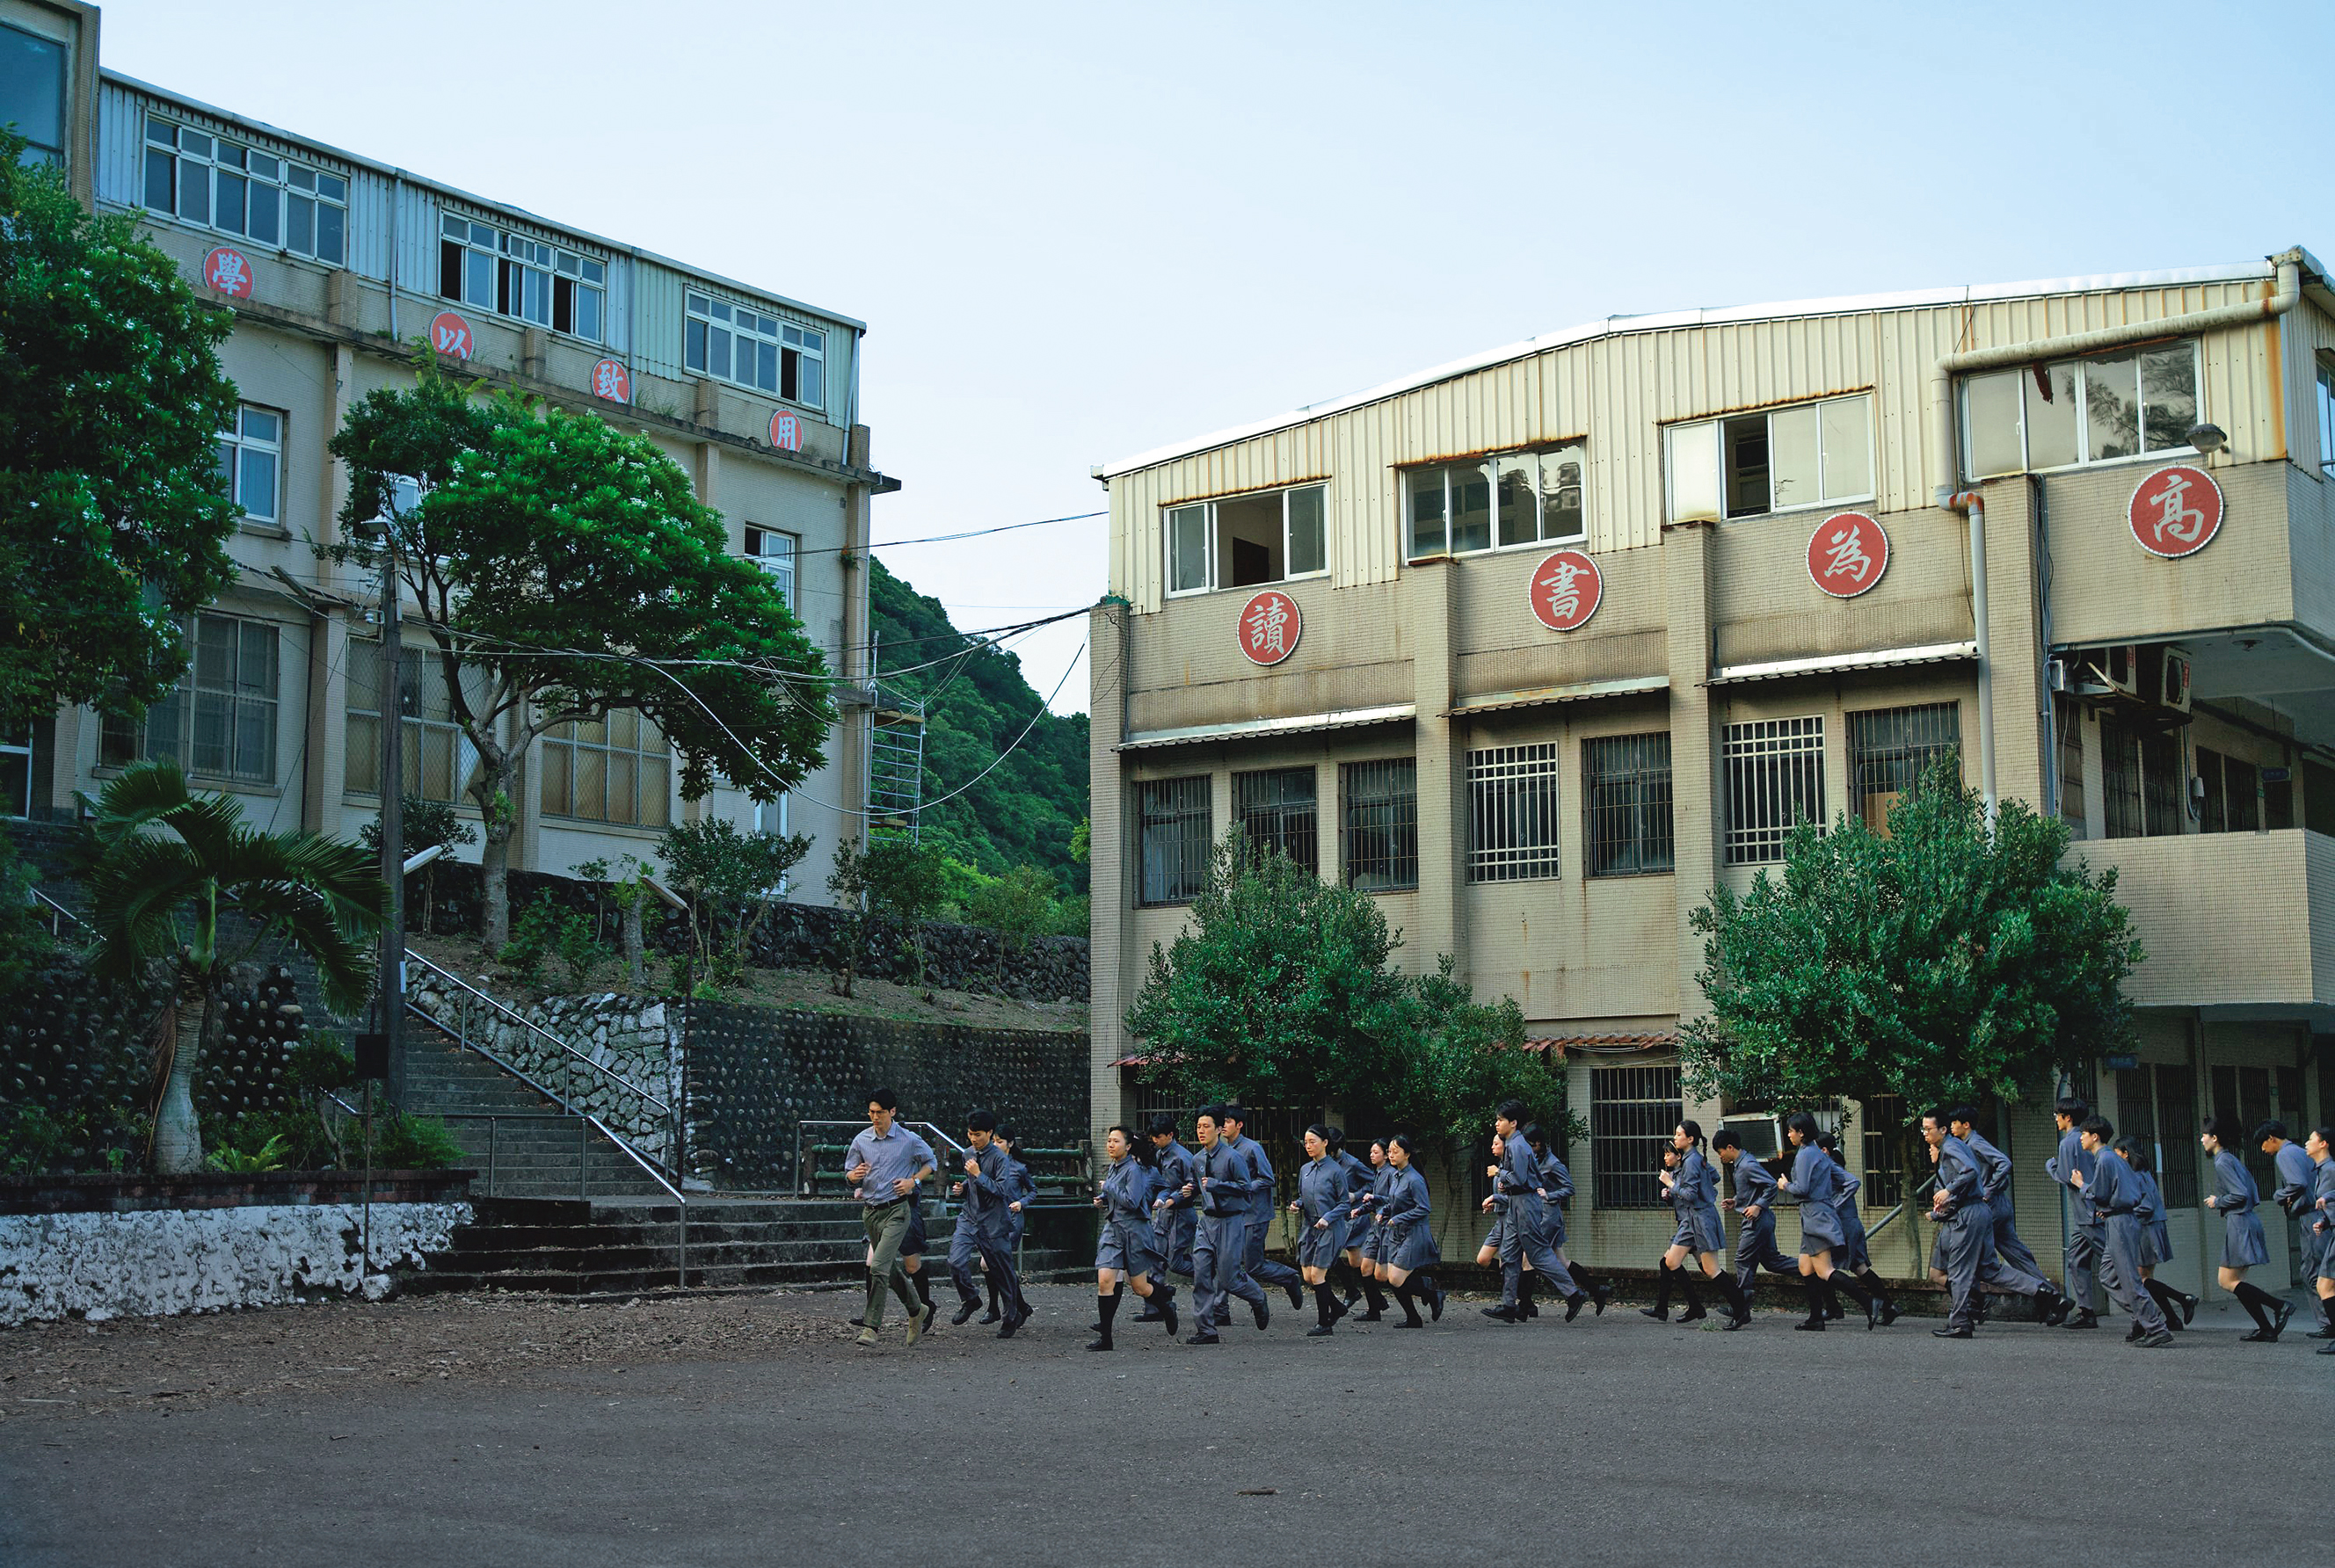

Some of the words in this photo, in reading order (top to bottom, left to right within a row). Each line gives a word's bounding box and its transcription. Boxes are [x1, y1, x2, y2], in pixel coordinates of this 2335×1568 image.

[212, 252, 247, 294] 學
[440, 325, 467, 359] 以
[598, 364, 626, 403] 致
[776, 416, 797, 452] 用
[1246, 597, 1290, 655] 讀
[1539, 561, 1592, 621] 書
[1823, 524, 1873, 583] 為
[2149, 474, 2205, 544] 高
